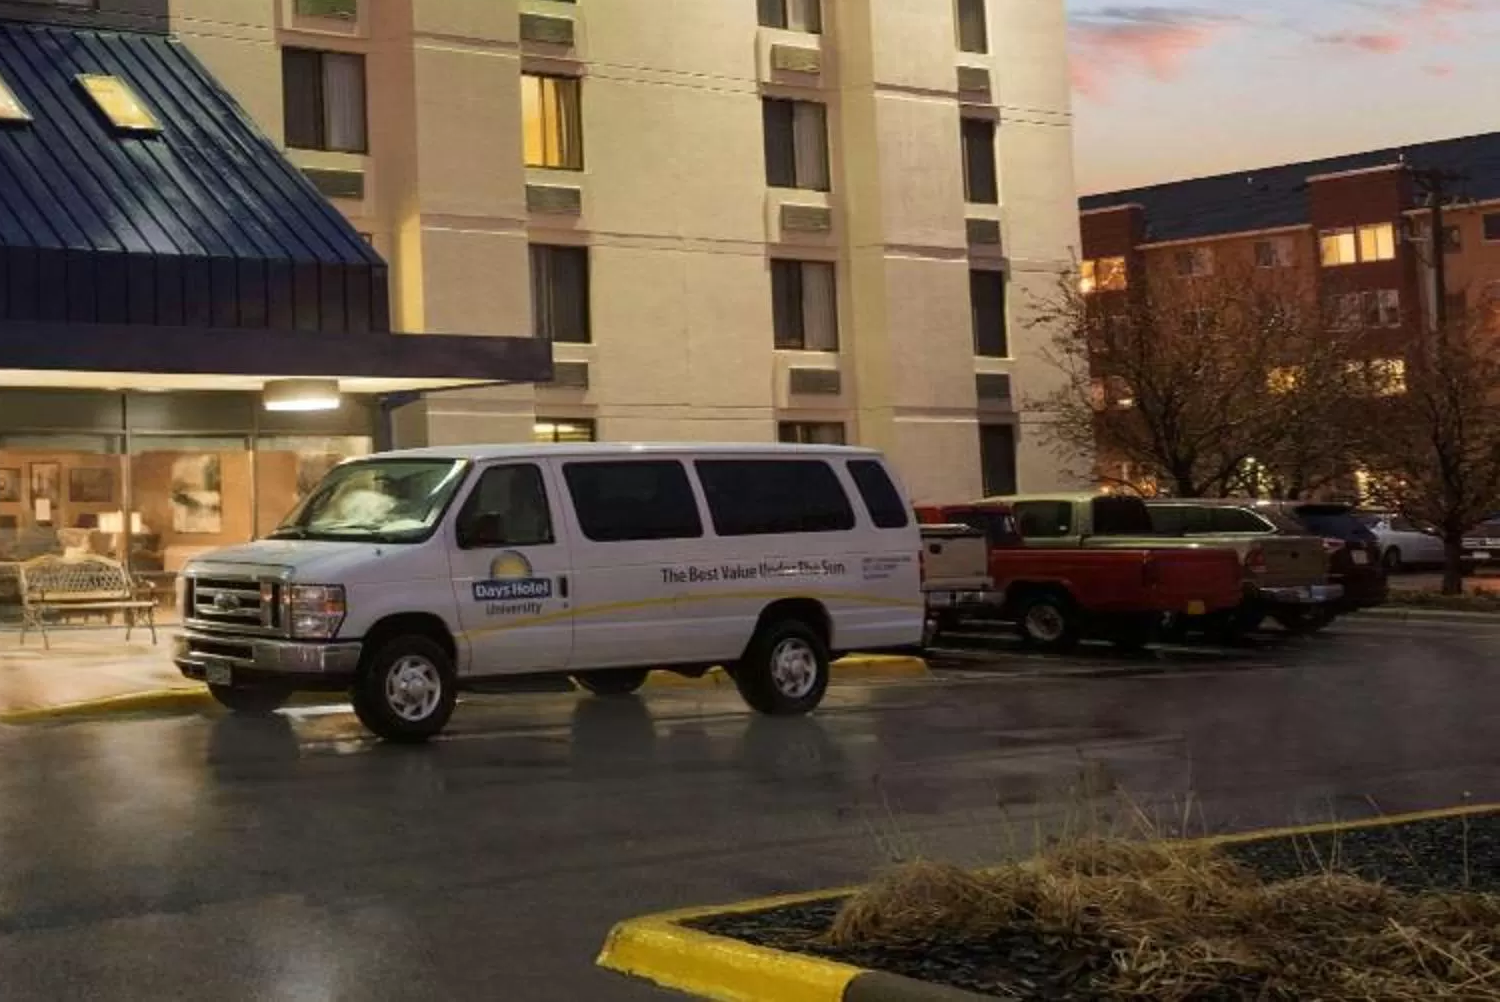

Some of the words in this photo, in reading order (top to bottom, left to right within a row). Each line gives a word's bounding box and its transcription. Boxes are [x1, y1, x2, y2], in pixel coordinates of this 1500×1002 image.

[661, 566, 687, 583] The
[689, 565, 718, 582] Best
[721, 563, 757, 580] Value
[821, 558, 845, 575] Sun
[475, 584, 510, 598] Days
[512, 581, 549, 596] Hotel
[486, 602, 542, 616] University
